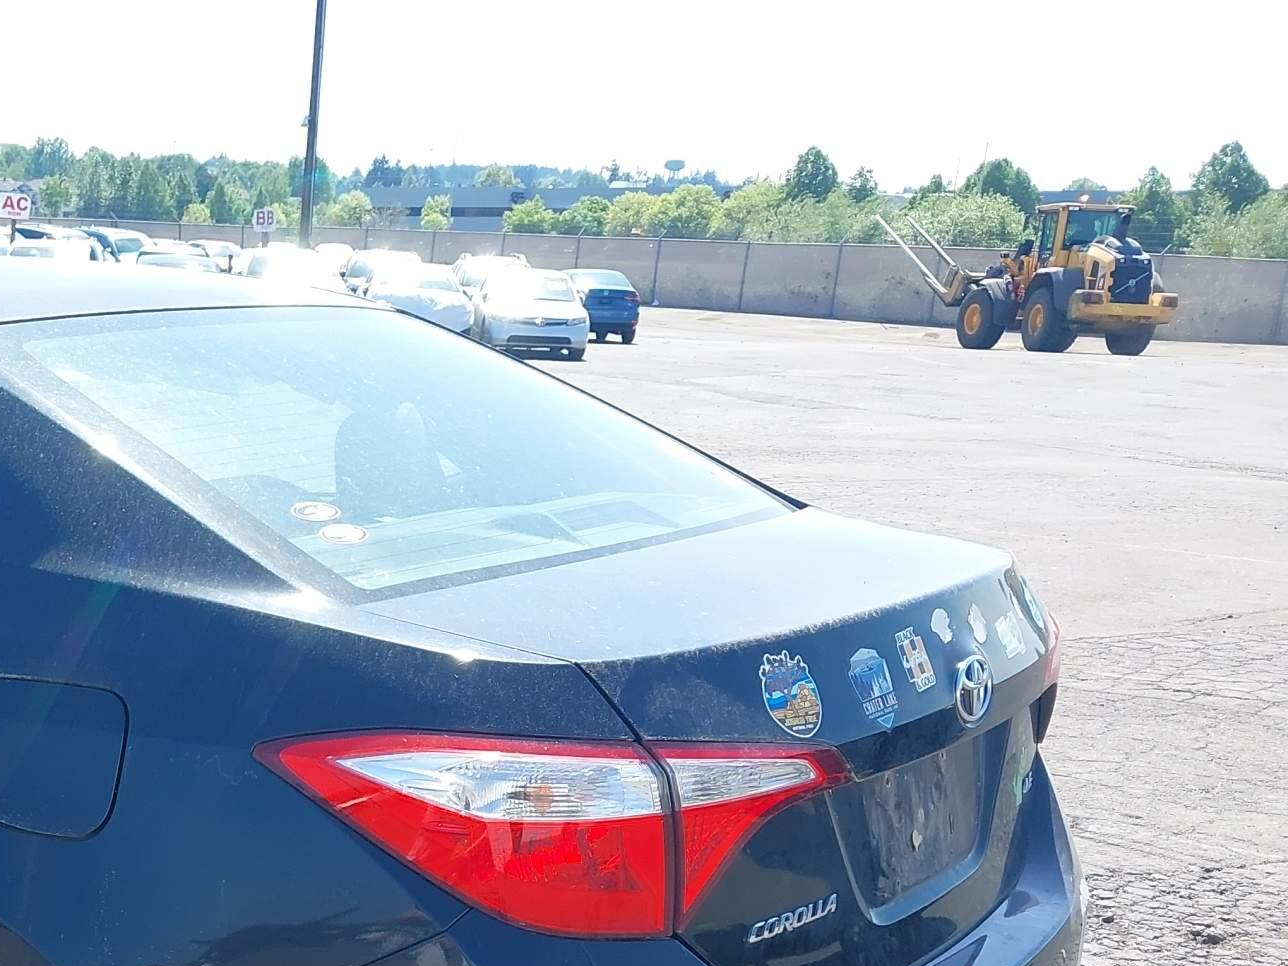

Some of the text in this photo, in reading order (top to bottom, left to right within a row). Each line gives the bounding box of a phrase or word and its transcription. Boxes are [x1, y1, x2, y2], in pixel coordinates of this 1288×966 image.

[2, 195, 29, 211] AC
[256, 210, 274, 225] BB
[862, 698, 885, 716] CRATER
[883, 691, 899, 706] LAKE
[747, 893, 838, 944] COROLLA
